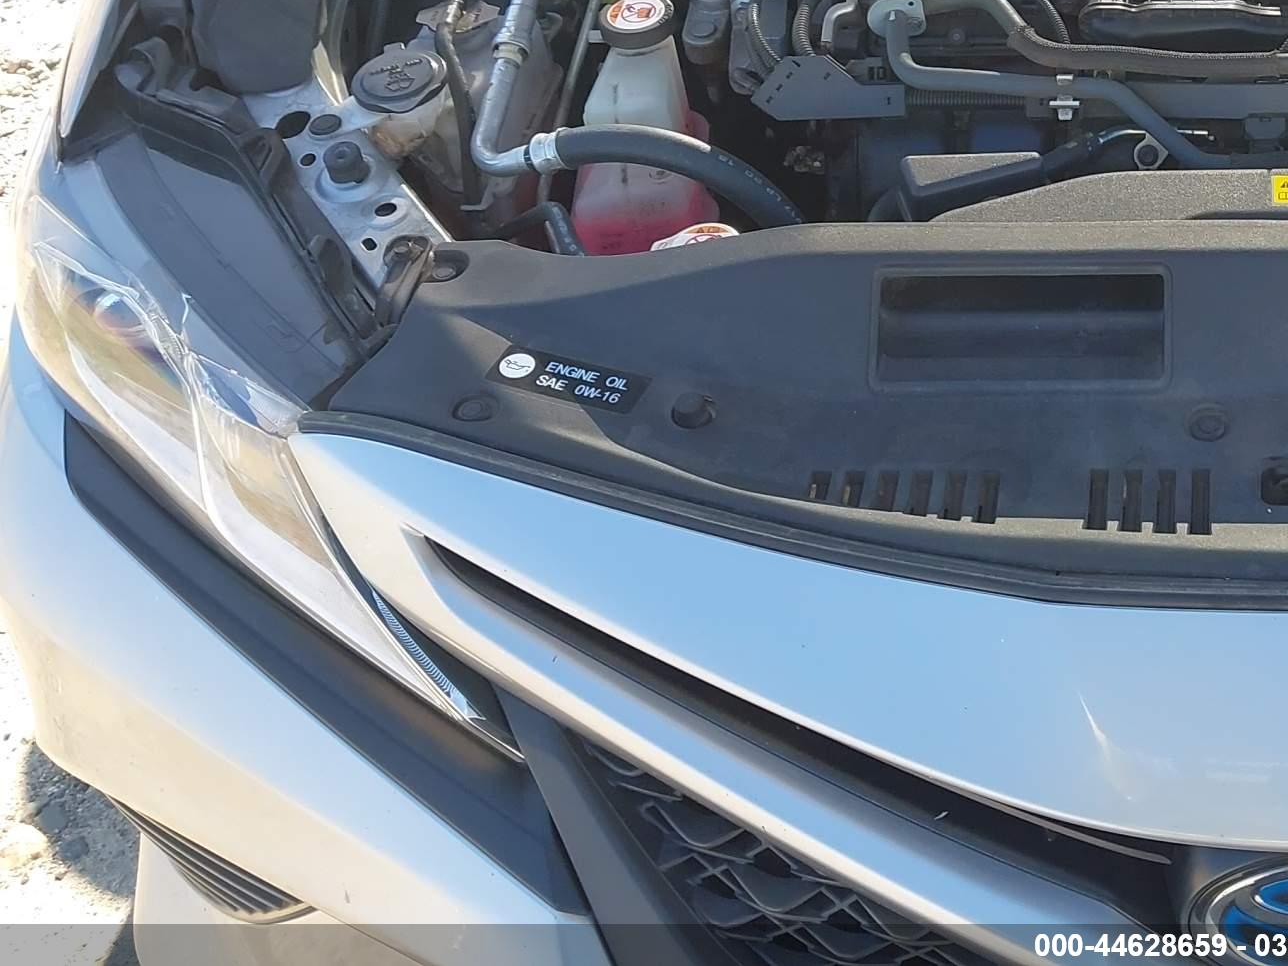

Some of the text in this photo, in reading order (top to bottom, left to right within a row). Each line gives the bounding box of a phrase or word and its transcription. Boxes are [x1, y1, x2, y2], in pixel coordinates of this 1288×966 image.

[536, 374, 621, 404] SAE 0W-16
[545, 361, 629, 391] ENGINE OIL
